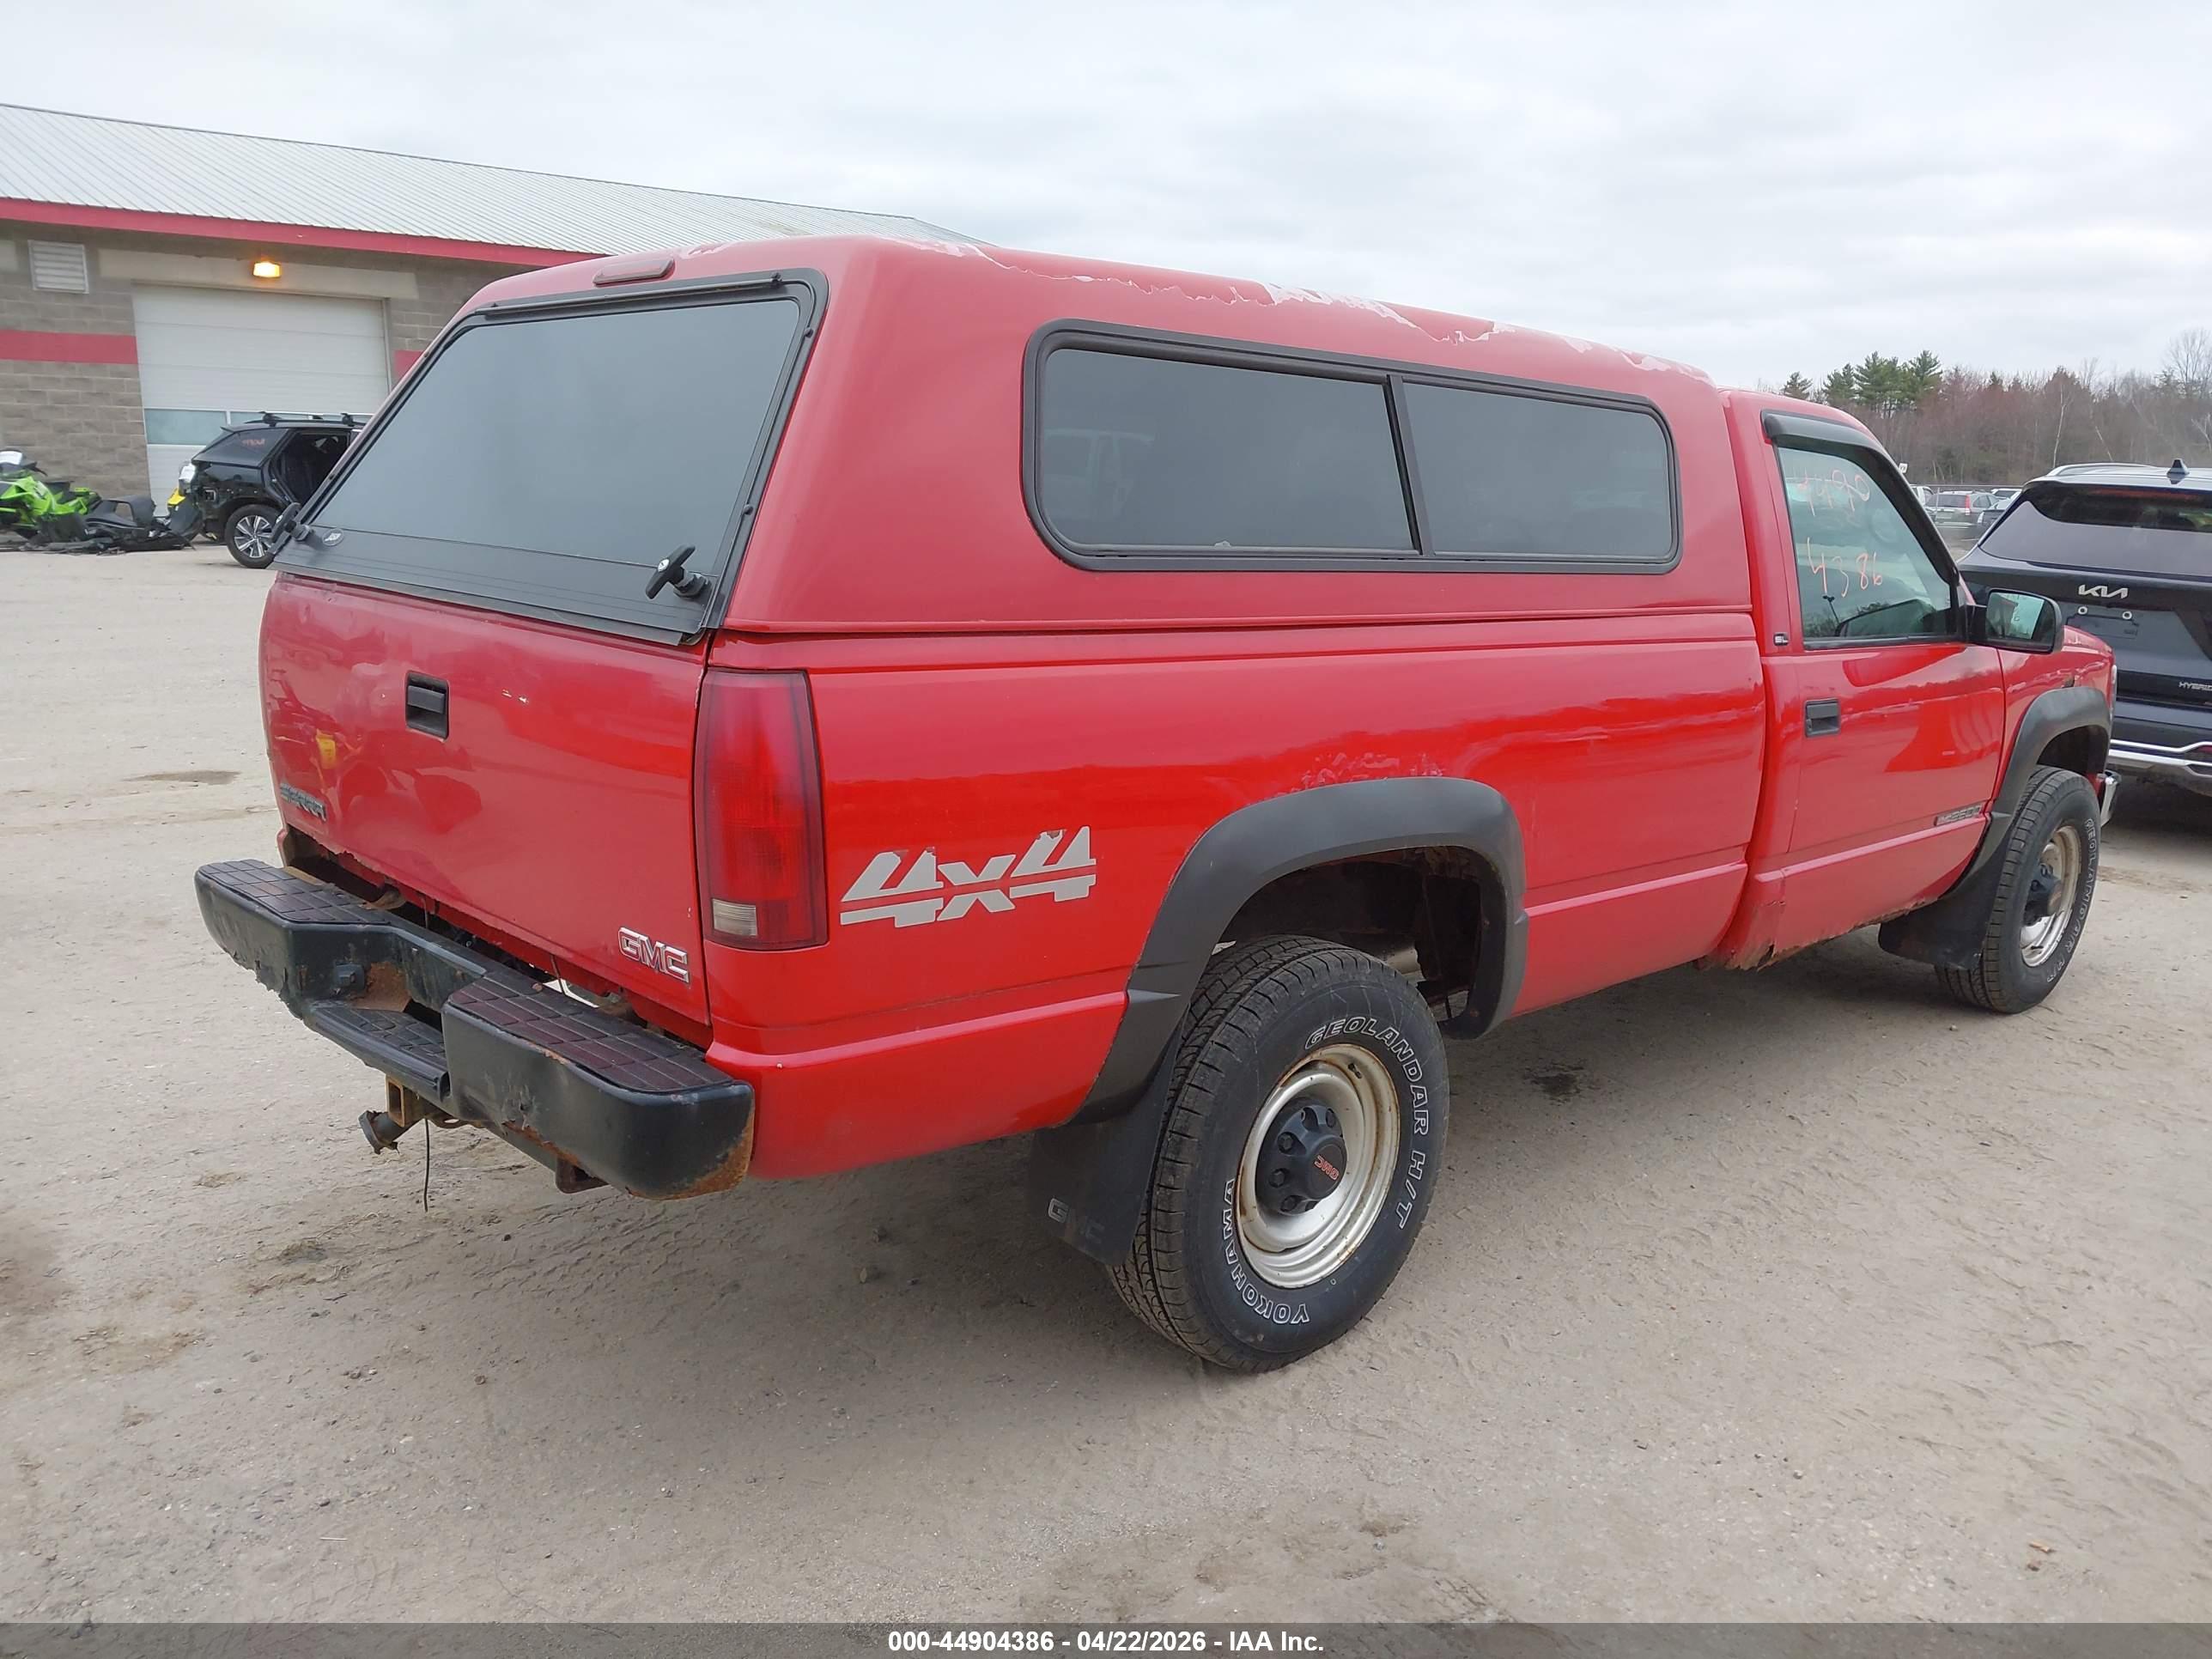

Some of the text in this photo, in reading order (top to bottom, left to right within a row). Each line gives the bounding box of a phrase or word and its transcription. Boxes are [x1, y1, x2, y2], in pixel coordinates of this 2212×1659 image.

[1807, 537, 1883, 598] 4386
[2078, 584, 2129, 599] KIA
[617, 926, 690, 984] GMC
[1304, 1016, 1431, 1231] GEOLANDAR H/T
[1314, 1154, 1340, 1181] GMC
[1221, 1177, 1310, 1325] YOKOHAMA
